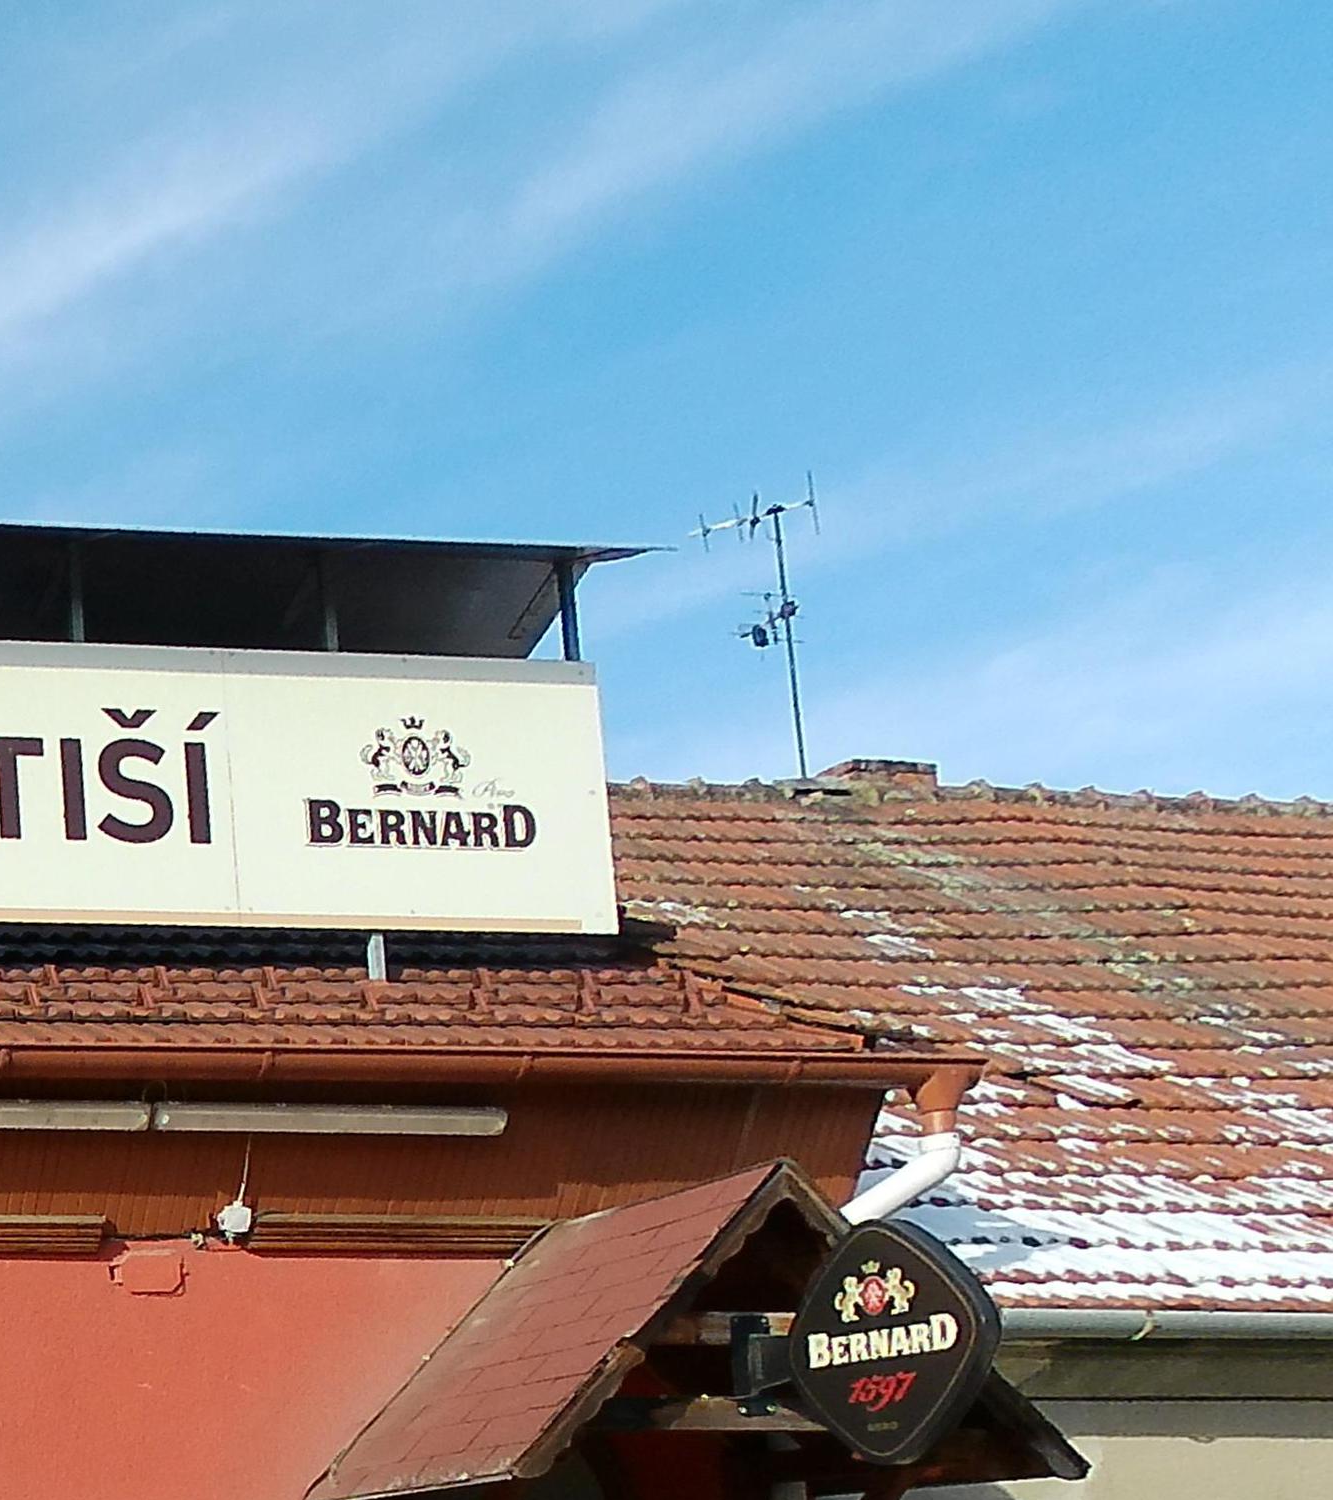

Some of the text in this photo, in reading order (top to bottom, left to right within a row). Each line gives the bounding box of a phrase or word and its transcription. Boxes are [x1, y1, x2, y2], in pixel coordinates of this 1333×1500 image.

[304, 798, 537, 851] BERNARD
[807, 1313, 958, 1369] BERNARD
[849, 1371, 916, 1412] 1597
